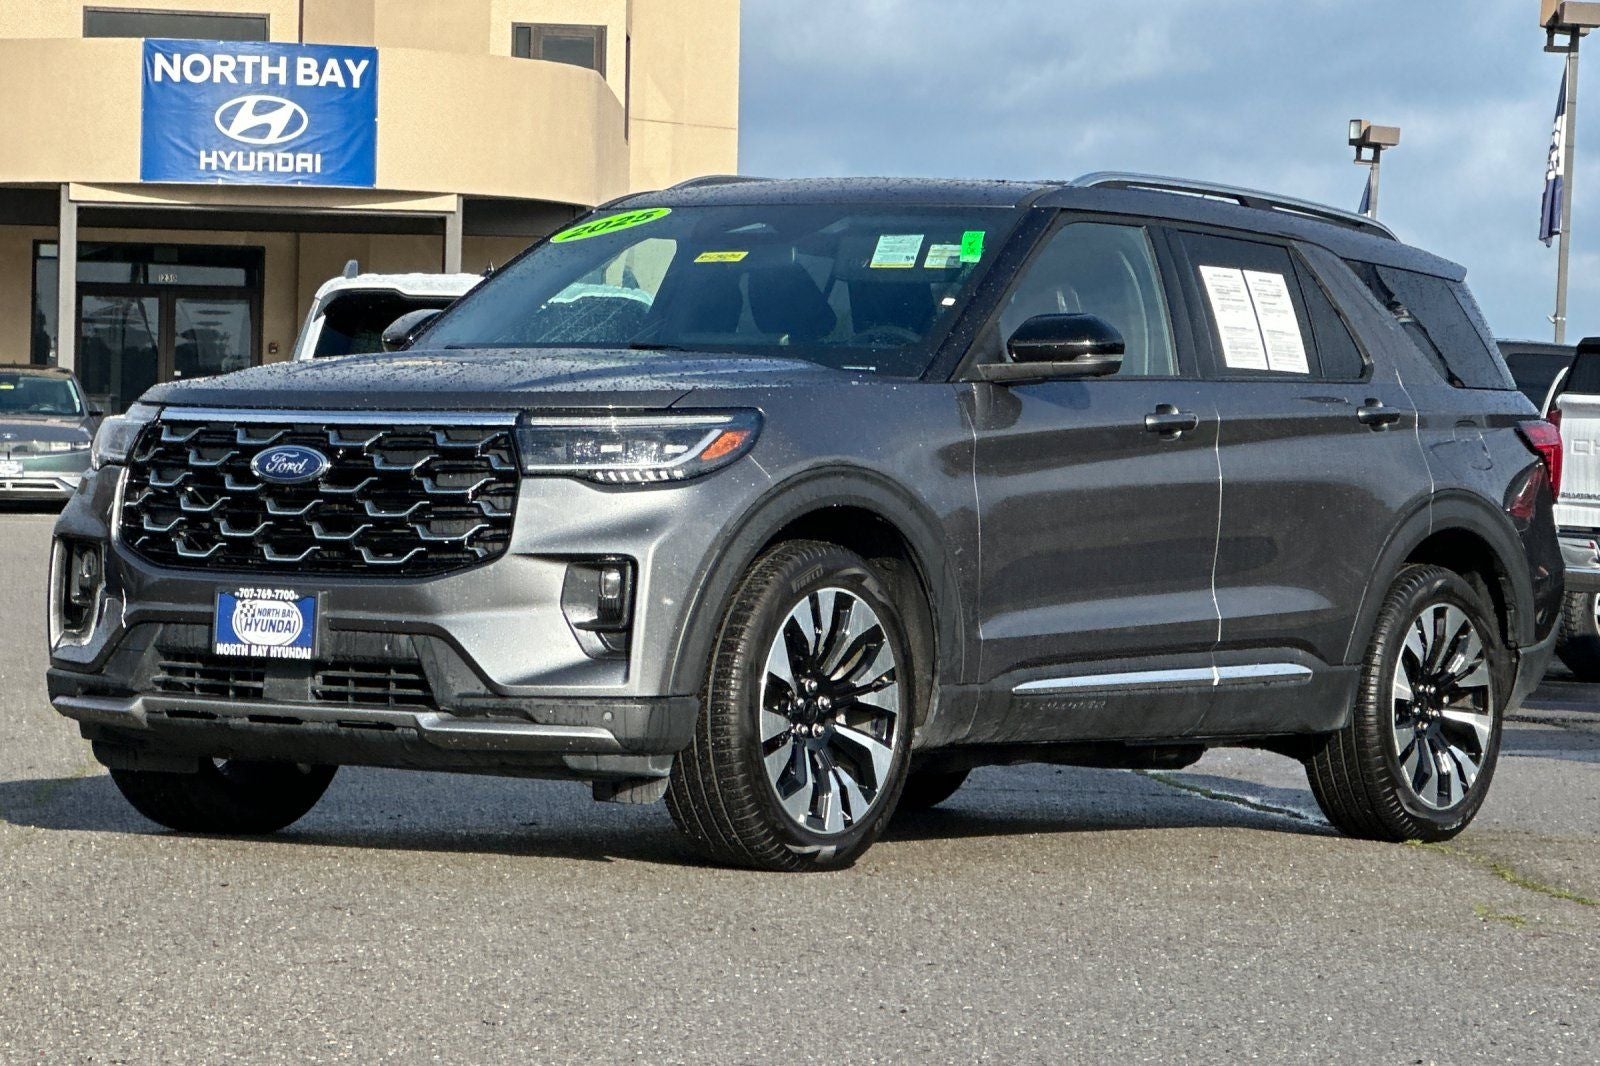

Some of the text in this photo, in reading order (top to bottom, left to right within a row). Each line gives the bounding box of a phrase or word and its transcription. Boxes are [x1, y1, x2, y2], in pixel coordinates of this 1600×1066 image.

[153, 52, 370, 89] NORTH BAY
[199, 150, 322, 173] HYUNDAI
[561, 209, 660, 240] 2025
[265, 452, 309, 474] Ford
[257, 608, 294, 618] NORTH BAY
[244, 620, 296, 633] HYUNDAI
[216, 643, 312, 660] NORTH BAY HYUNDAI
